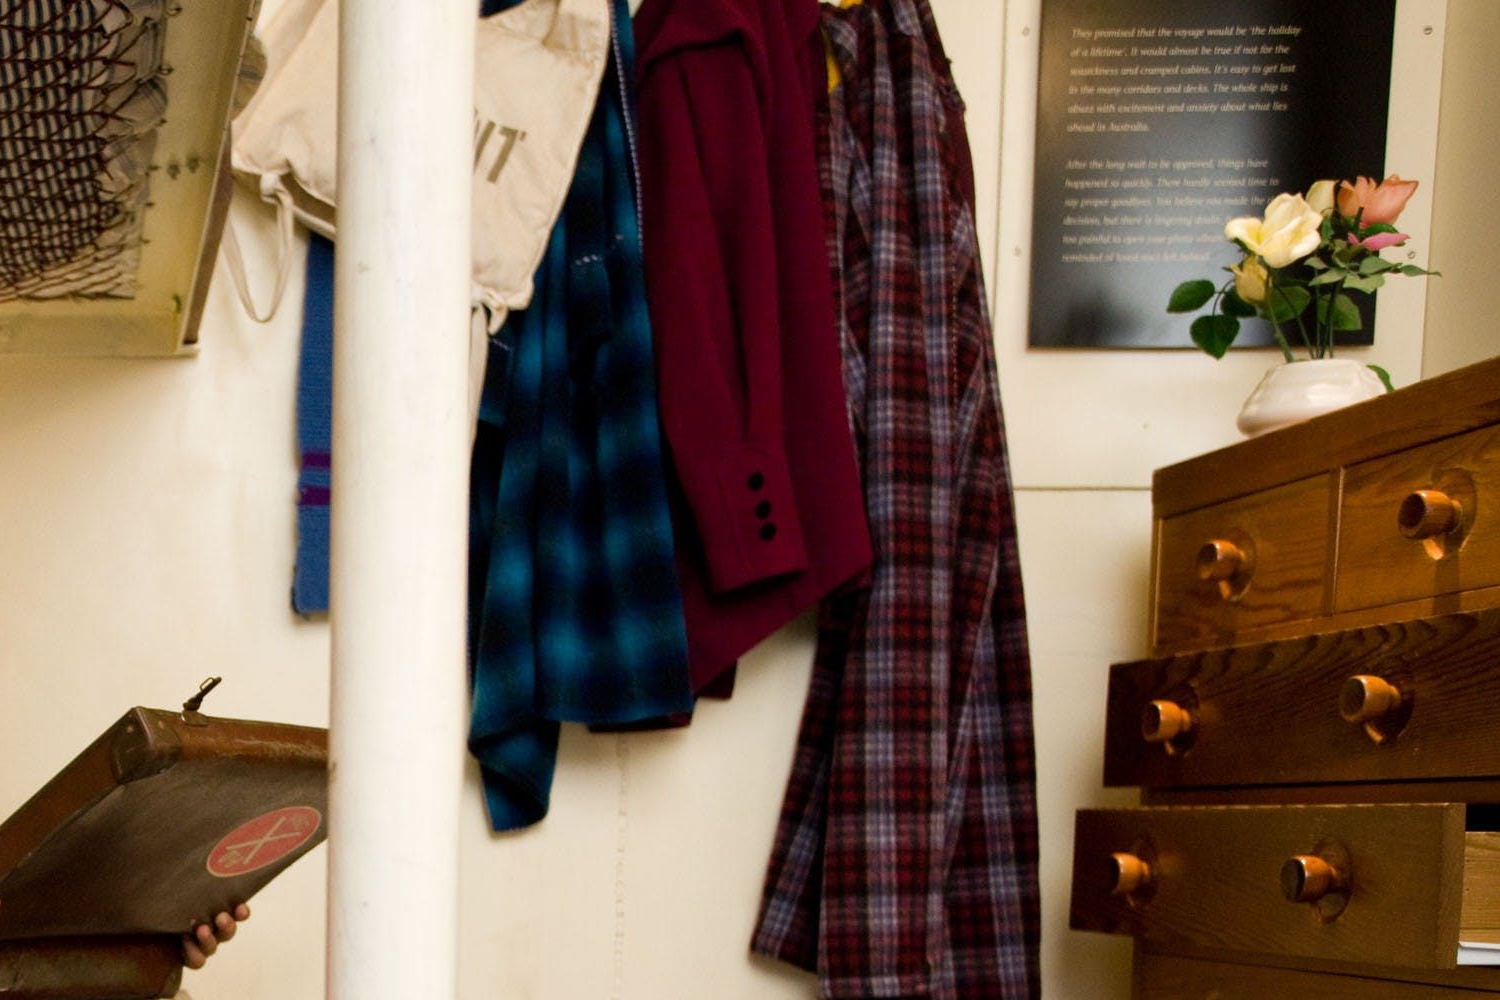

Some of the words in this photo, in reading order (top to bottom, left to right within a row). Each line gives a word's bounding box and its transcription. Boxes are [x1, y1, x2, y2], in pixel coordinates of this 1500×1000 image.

[1071, 28, 1092, 40] They
[1094, 27, 1134, 40] promised
[1137, 27, 1156, 37] that
[1158, 26, 1172, 37] the
[1174, 28, 1205, 39] voyage
[1207, 26, 1234, 36] would
[1236, 26, 1246, 36] be
[1268, 25, 1300, 37] holiday
[1140, 46, 1167, 57] would
[1168, 46, 1198, 56] almost
[1201, 45, 1212, 55] be
[1214, 45, 1232, 55] true
[1234, 44, 1243, 55] if
[1243, 46, 1259, 55] not
[1260, 45, 1274, 55] for
[1275, 44, 1290, 55] the
[1120, 65, 1139, 76] and
[1140, 65, 1179, 77] cramped
[1230, 65, 1249, 76] easy
[1252, 64, 1262, 74] to
[1262, 64, 1278, 76] get
[1279, 63, 1296, 73] lost
[1080, 85, 1094, 95] the
[1097, 86, 1122, 97] many
[1123, 84, 1162, 95] corridors
[1164, 84, 1182, 94] and
[1213, 83, 1229, 93] The
[1231, 82, 1257, 93] whole
[1260, 82, 1278, 94] ship
[1280, 82, 1288, 92] is
[1096, 103, 1116, 113] with
[1118, 102, 1165, 113] excitement
[1167, 102, 1185, 113] and
[1186, 102, 1217, 114] anxiety
[1220, 101, 1246, 112] about
[1248, 101, 1271, 112] what
[1272, 101, 1288, 111] lies
[1089, 159, 1103, 169] the
[1247, 158, 1269, 168] have
